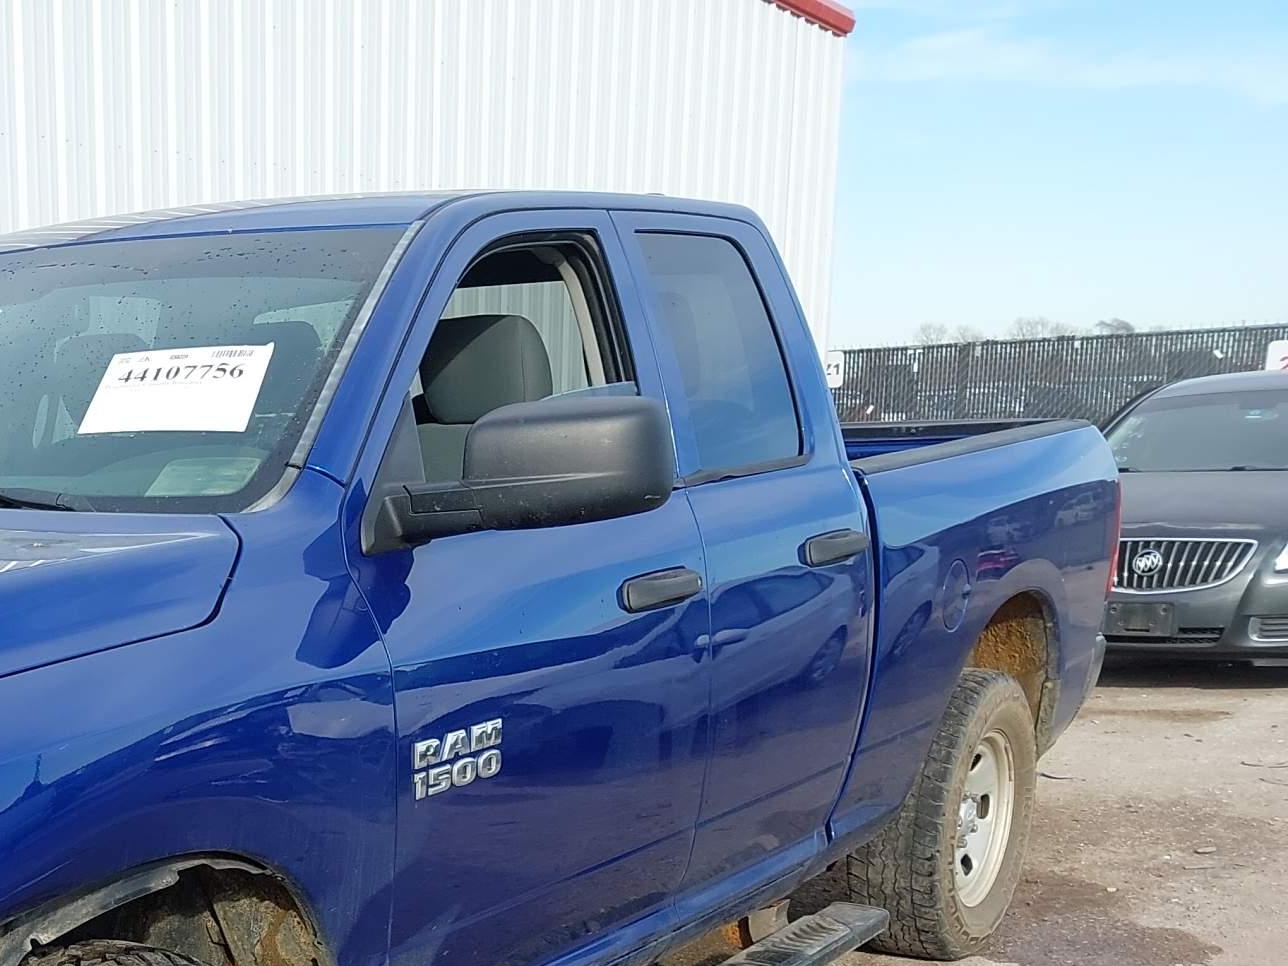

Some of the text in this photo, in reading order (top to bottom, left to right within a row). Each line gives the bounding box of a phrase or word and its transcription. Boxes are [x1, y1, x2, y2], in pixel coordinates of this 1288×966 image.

[118, 362, 245, 383] 44107756
[414, 718, 503, 770] RAM
[413, 749, 502, 800] 1500
